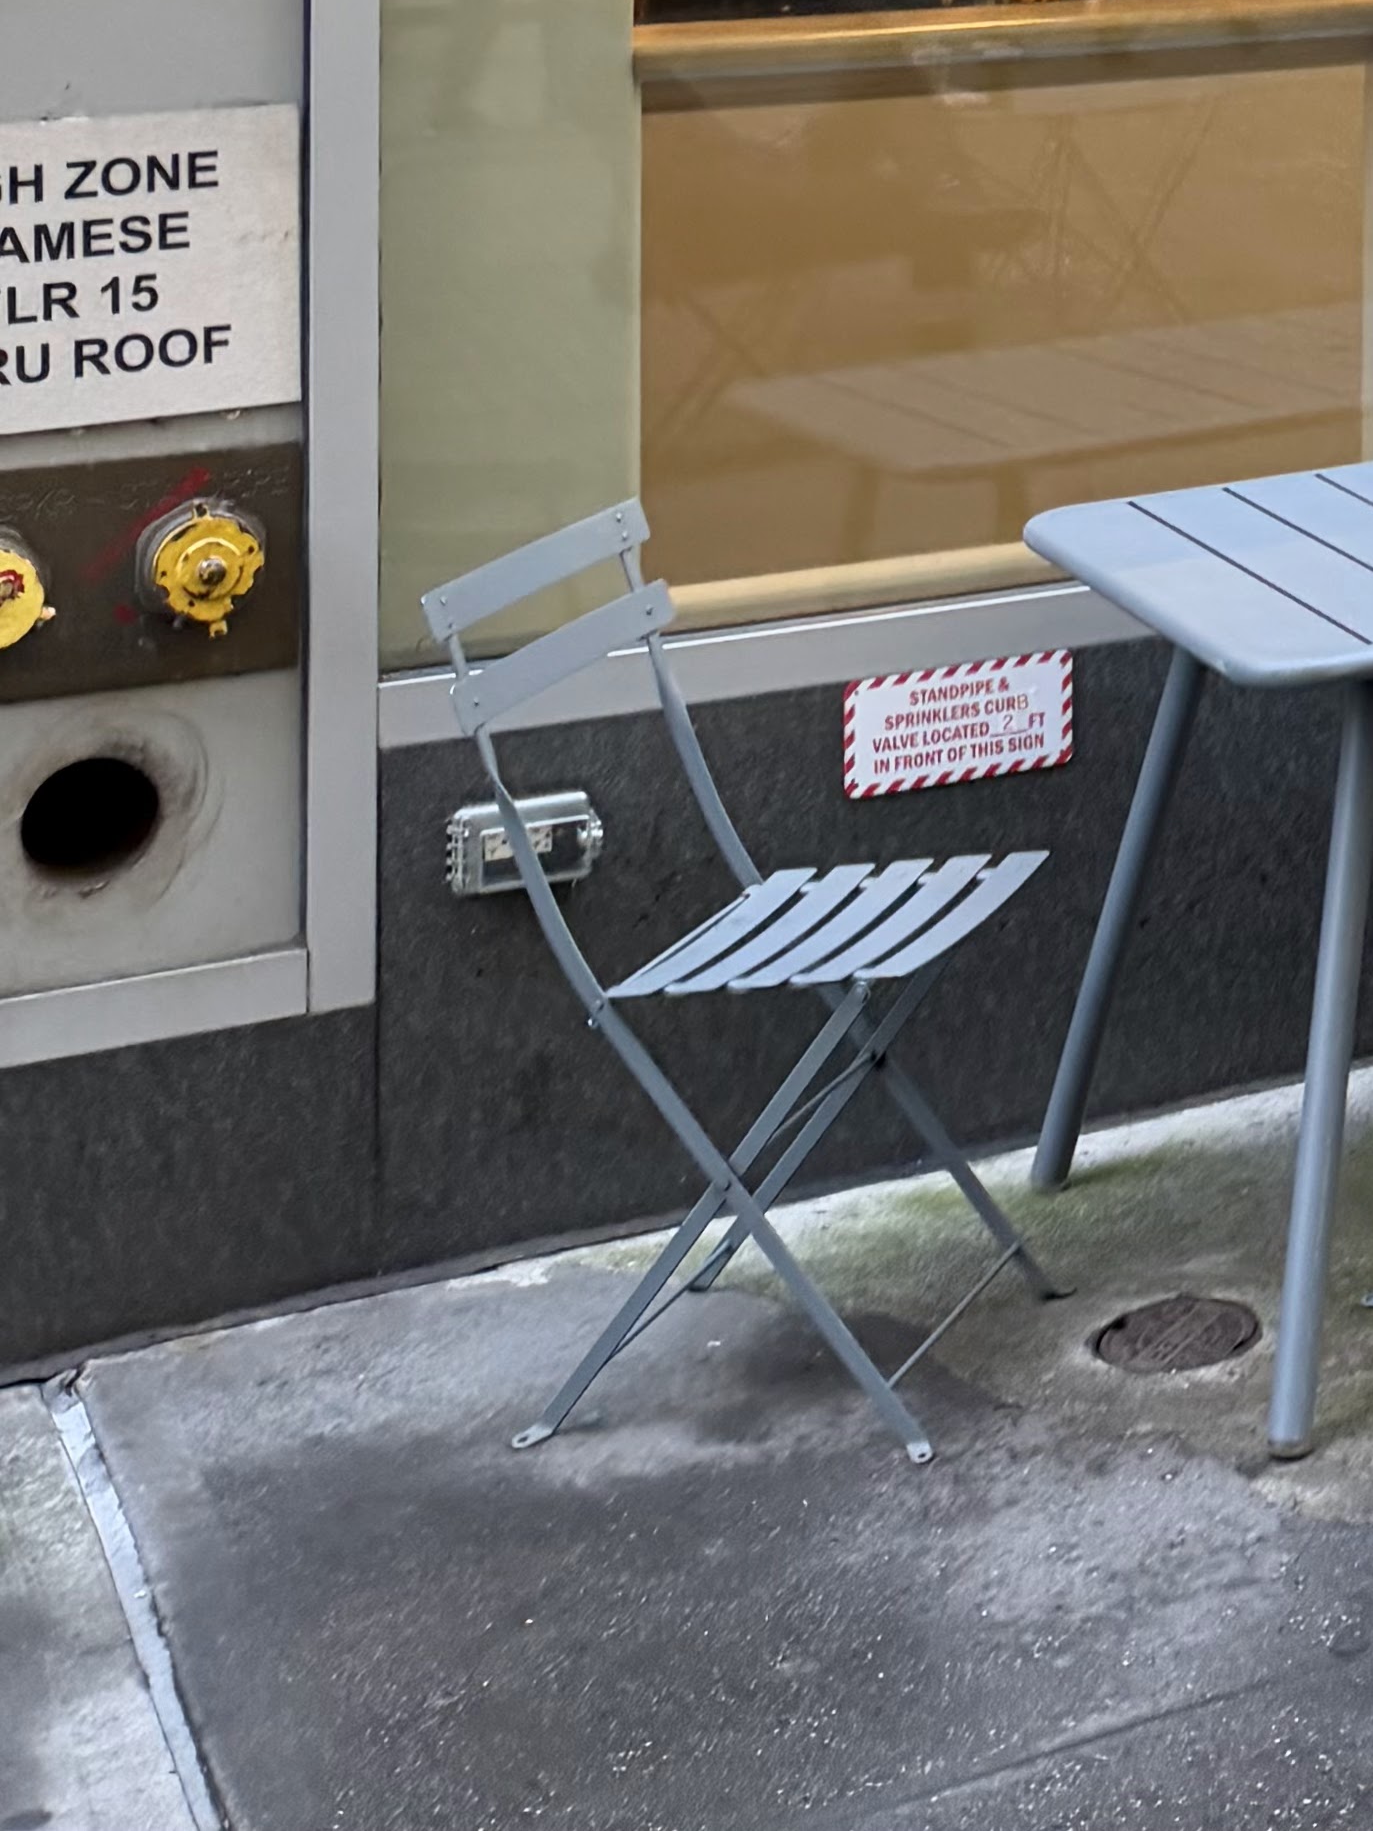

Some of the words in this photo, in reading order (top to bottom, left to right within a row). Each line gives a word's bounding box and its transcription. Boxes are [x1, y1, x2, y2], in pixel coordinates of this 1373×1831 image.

[0, 163, 44, 205] H
[64, 150, 219, 200] ZONE
[99, 273, 159, 316] 15
[73, 324, 232, 378] ROOF
[884, 701, 981, 731] SPRINKLERS
[984, 693, 1030, 714] CURB
[909, 681, 995, 706] STANDPIPE
[997, 676, 1010, 691] &
[872, 731, 919, 753] VALVE
[923, 722, 990, 747] LOCATED
[1028, 712, 1046, 730] FT
[874, 758, 890, 775] IN
[894, 748, 944, 772] FRONT
[947, 745, 967, 762] OF
[970, 740, 1004, 759] THIS
[1008, 732, 1045, 753] SIGN
